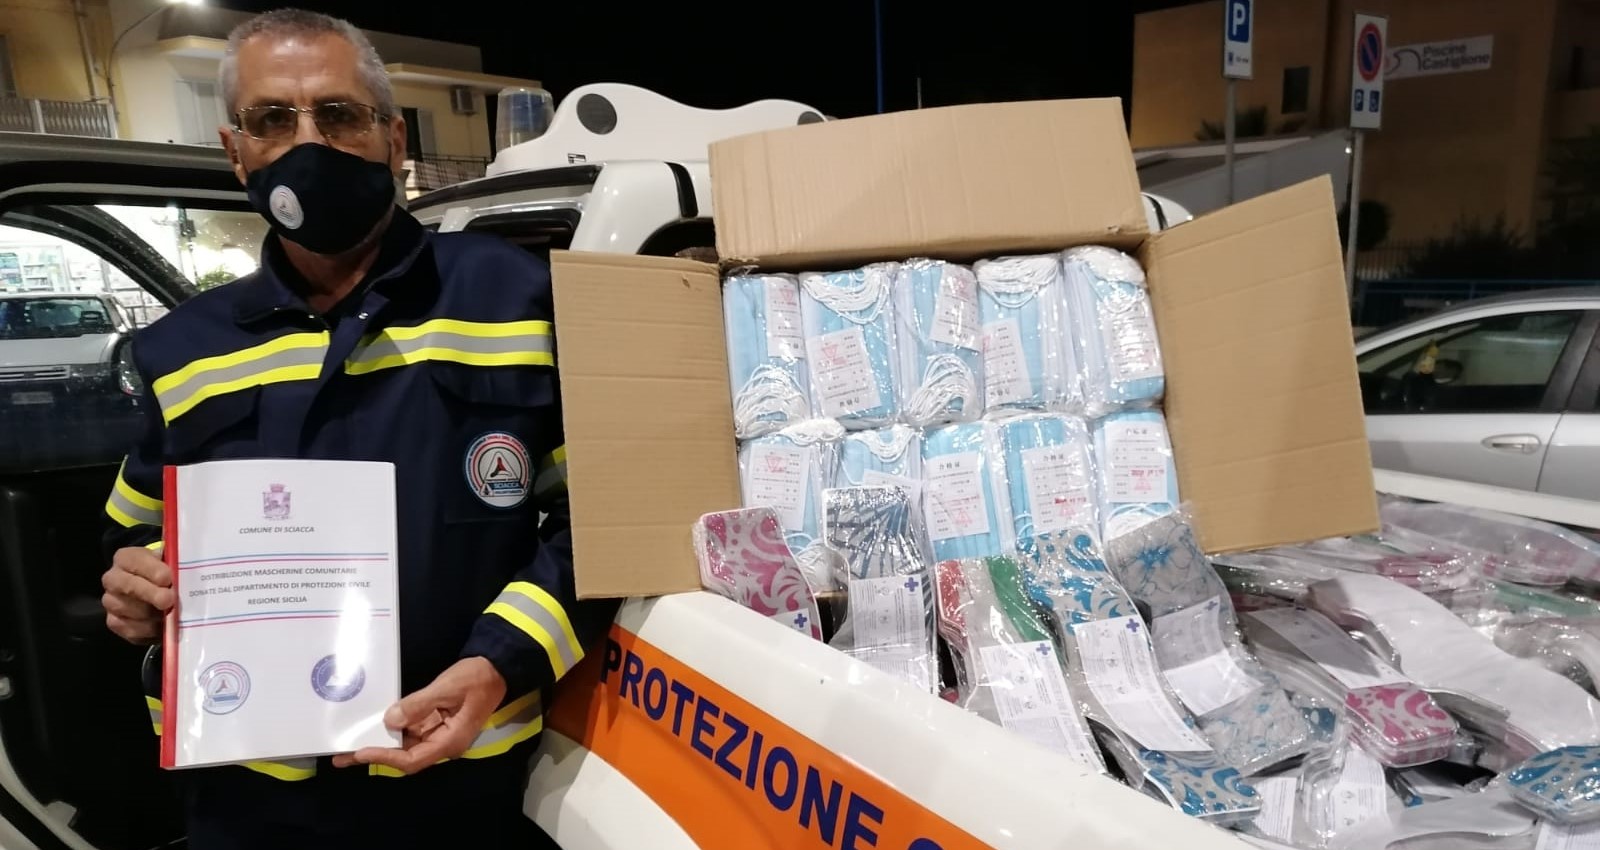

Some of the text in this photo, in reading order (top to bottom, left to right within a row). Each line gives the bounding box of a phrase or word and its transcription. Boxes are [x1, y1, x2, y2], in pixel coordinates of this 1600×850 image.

[1232, 2, 1246, 36] P
[1422, 54, 1490, 71] Castiglione
[200, 567, 357, 581] DISTRIBUZIONE MASCHERINE COMUNITARIE
[188, 588, 216, 597] DONATE
[218, 586, 232, 594] DAL
[233, 583, 289, 592] DIPARTIMENTO
[300, 581, 346, 589] PROTEZIONE
[247, 597, 280, 605] REGIONE
[600, 637, 884, 850] PROTEZIONE
